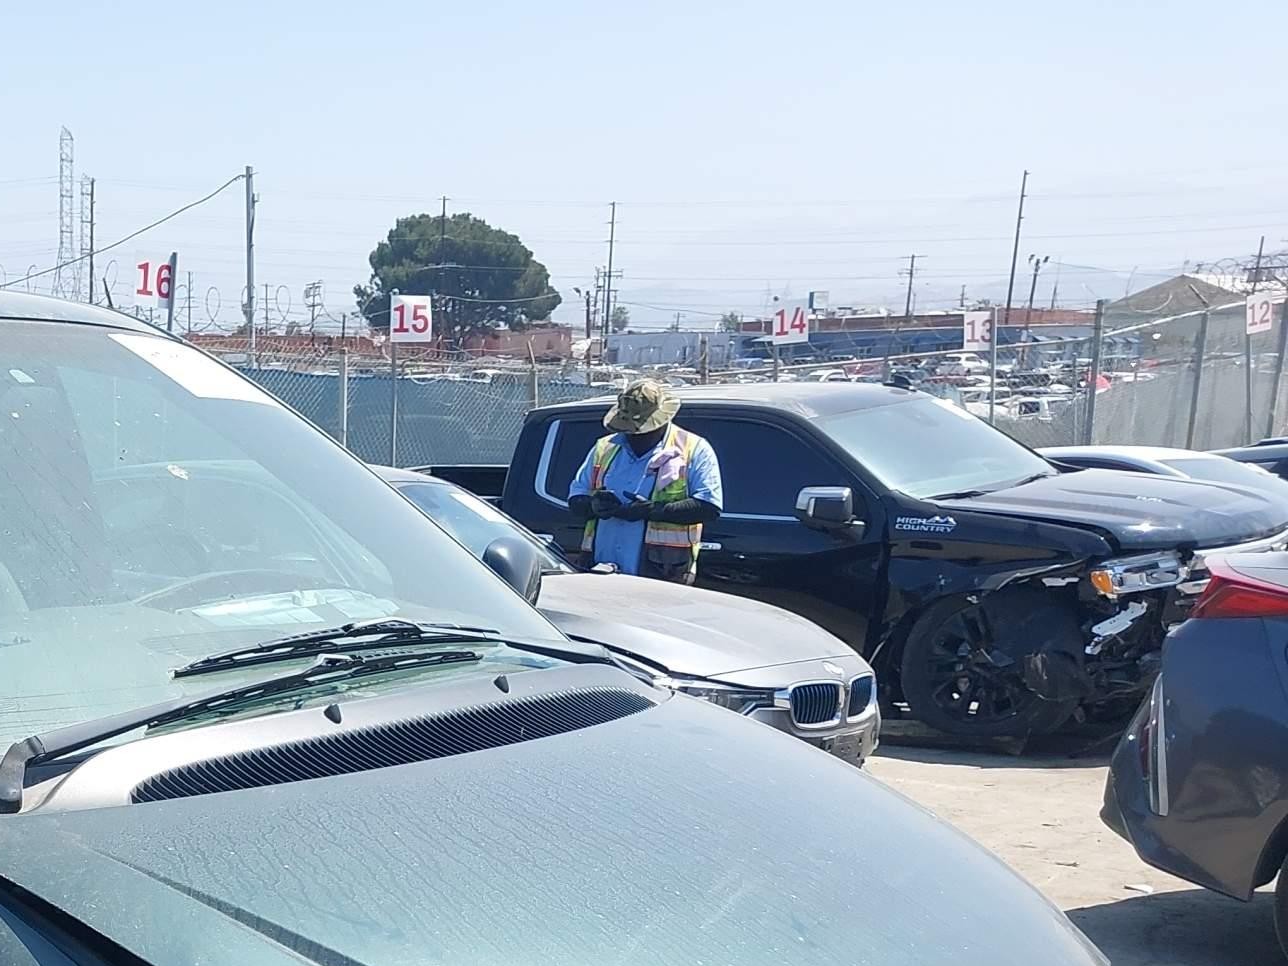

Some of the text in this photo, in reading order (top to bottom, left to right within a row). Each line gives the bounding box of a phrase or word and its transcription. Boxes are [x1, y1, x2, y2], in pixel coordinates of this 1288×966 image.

[137, 262, 172, 299] 16
[393, 303, 429, 334] 15
[775, 306, 807, 337] 14
[1248, 300, 1270, 327] 12
[966, 318, 993, 343] 13
[895, 523, 954, 533] COUNTRY
[896, 517, 928, 525] HIGH
